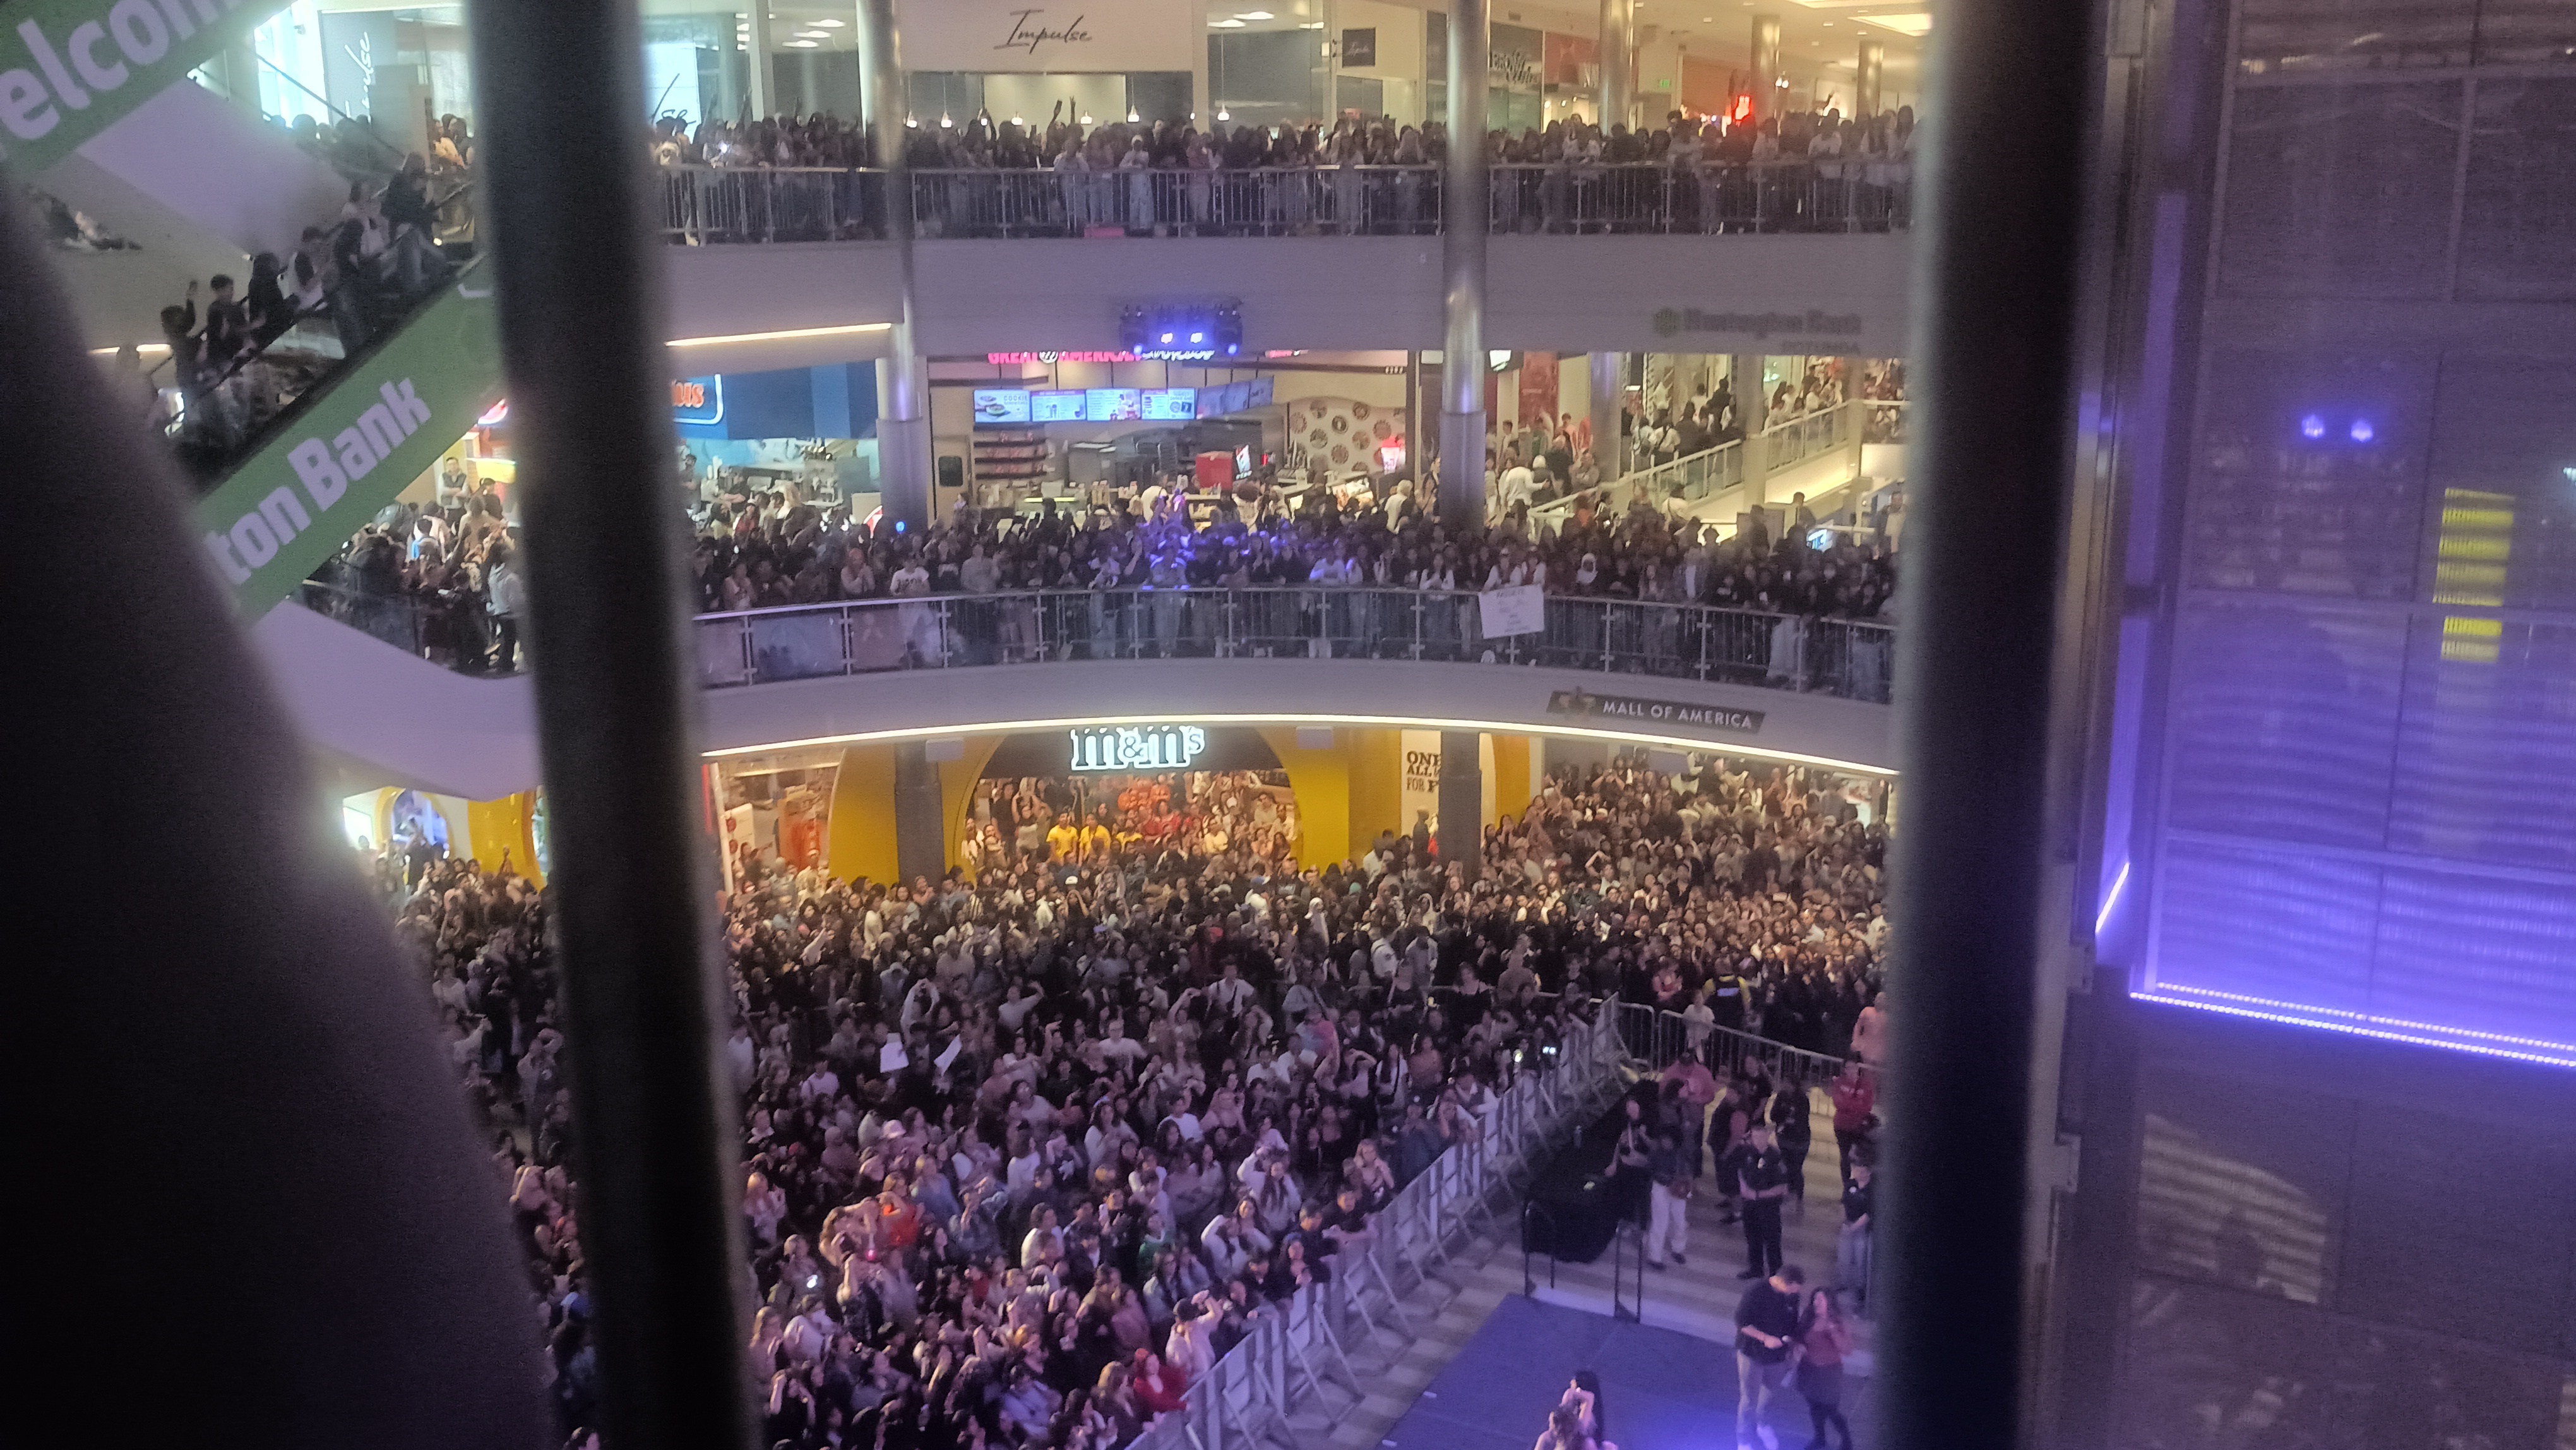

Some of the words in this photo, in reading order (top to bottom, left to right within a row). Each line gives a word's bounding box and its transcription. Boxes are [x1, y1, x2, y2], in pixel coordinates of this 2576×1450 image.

[993, 9, 1093, 55] Impulse
[287, 378, 432, 512] Bank
[1602, 700, 1645, 717] MALL
[1650, 704, 1674, 720] OF
[1677, 707, 1753, 729] AMERICA
